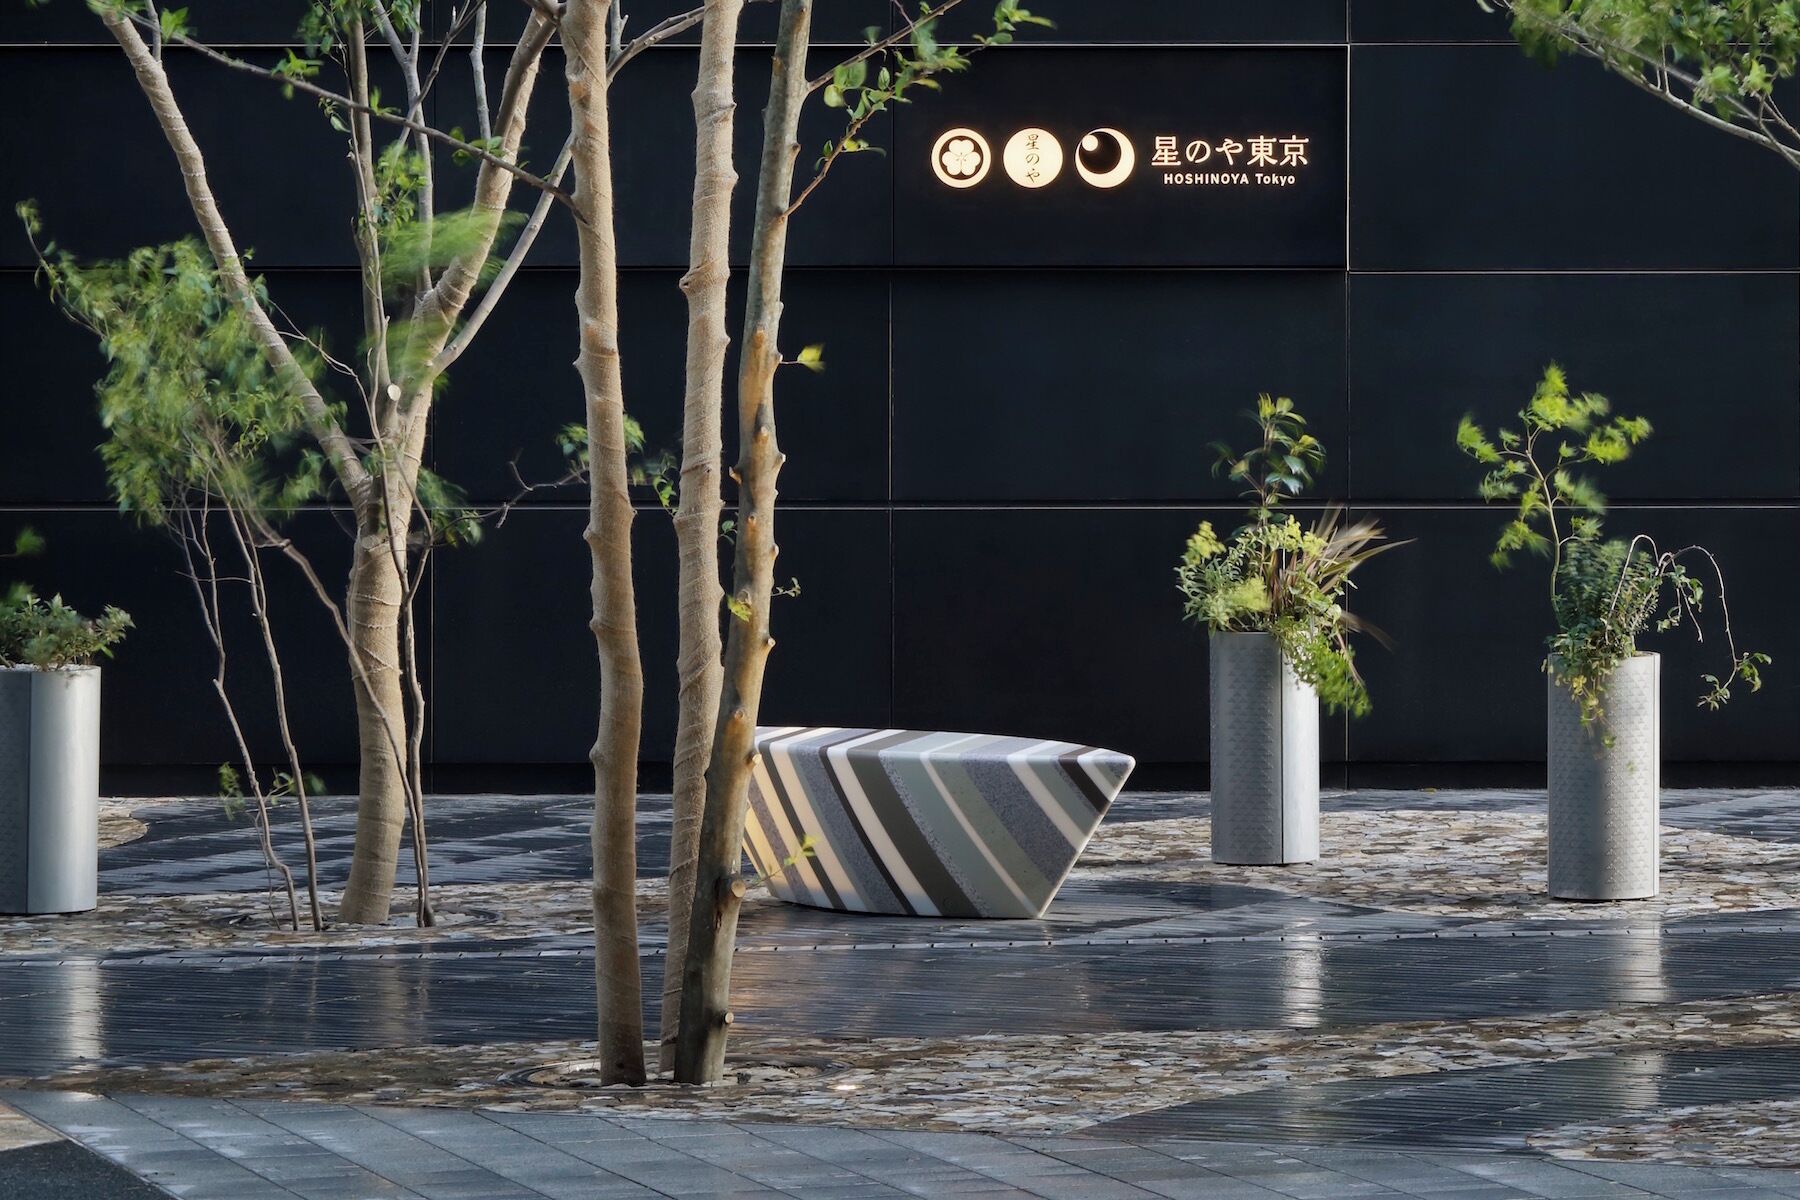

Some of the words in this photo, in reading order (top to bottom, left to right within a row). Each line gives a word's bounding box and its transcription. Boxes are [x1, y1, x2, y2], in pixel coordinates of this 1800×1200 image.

[1025, 133, 1040, 183] 星のや
[1152, 135, 1309, 167] 星のや東京
[1164, 173, 1249, 184] HOSHINOYA
[1255, 173, 1295, 186] Tokyo
